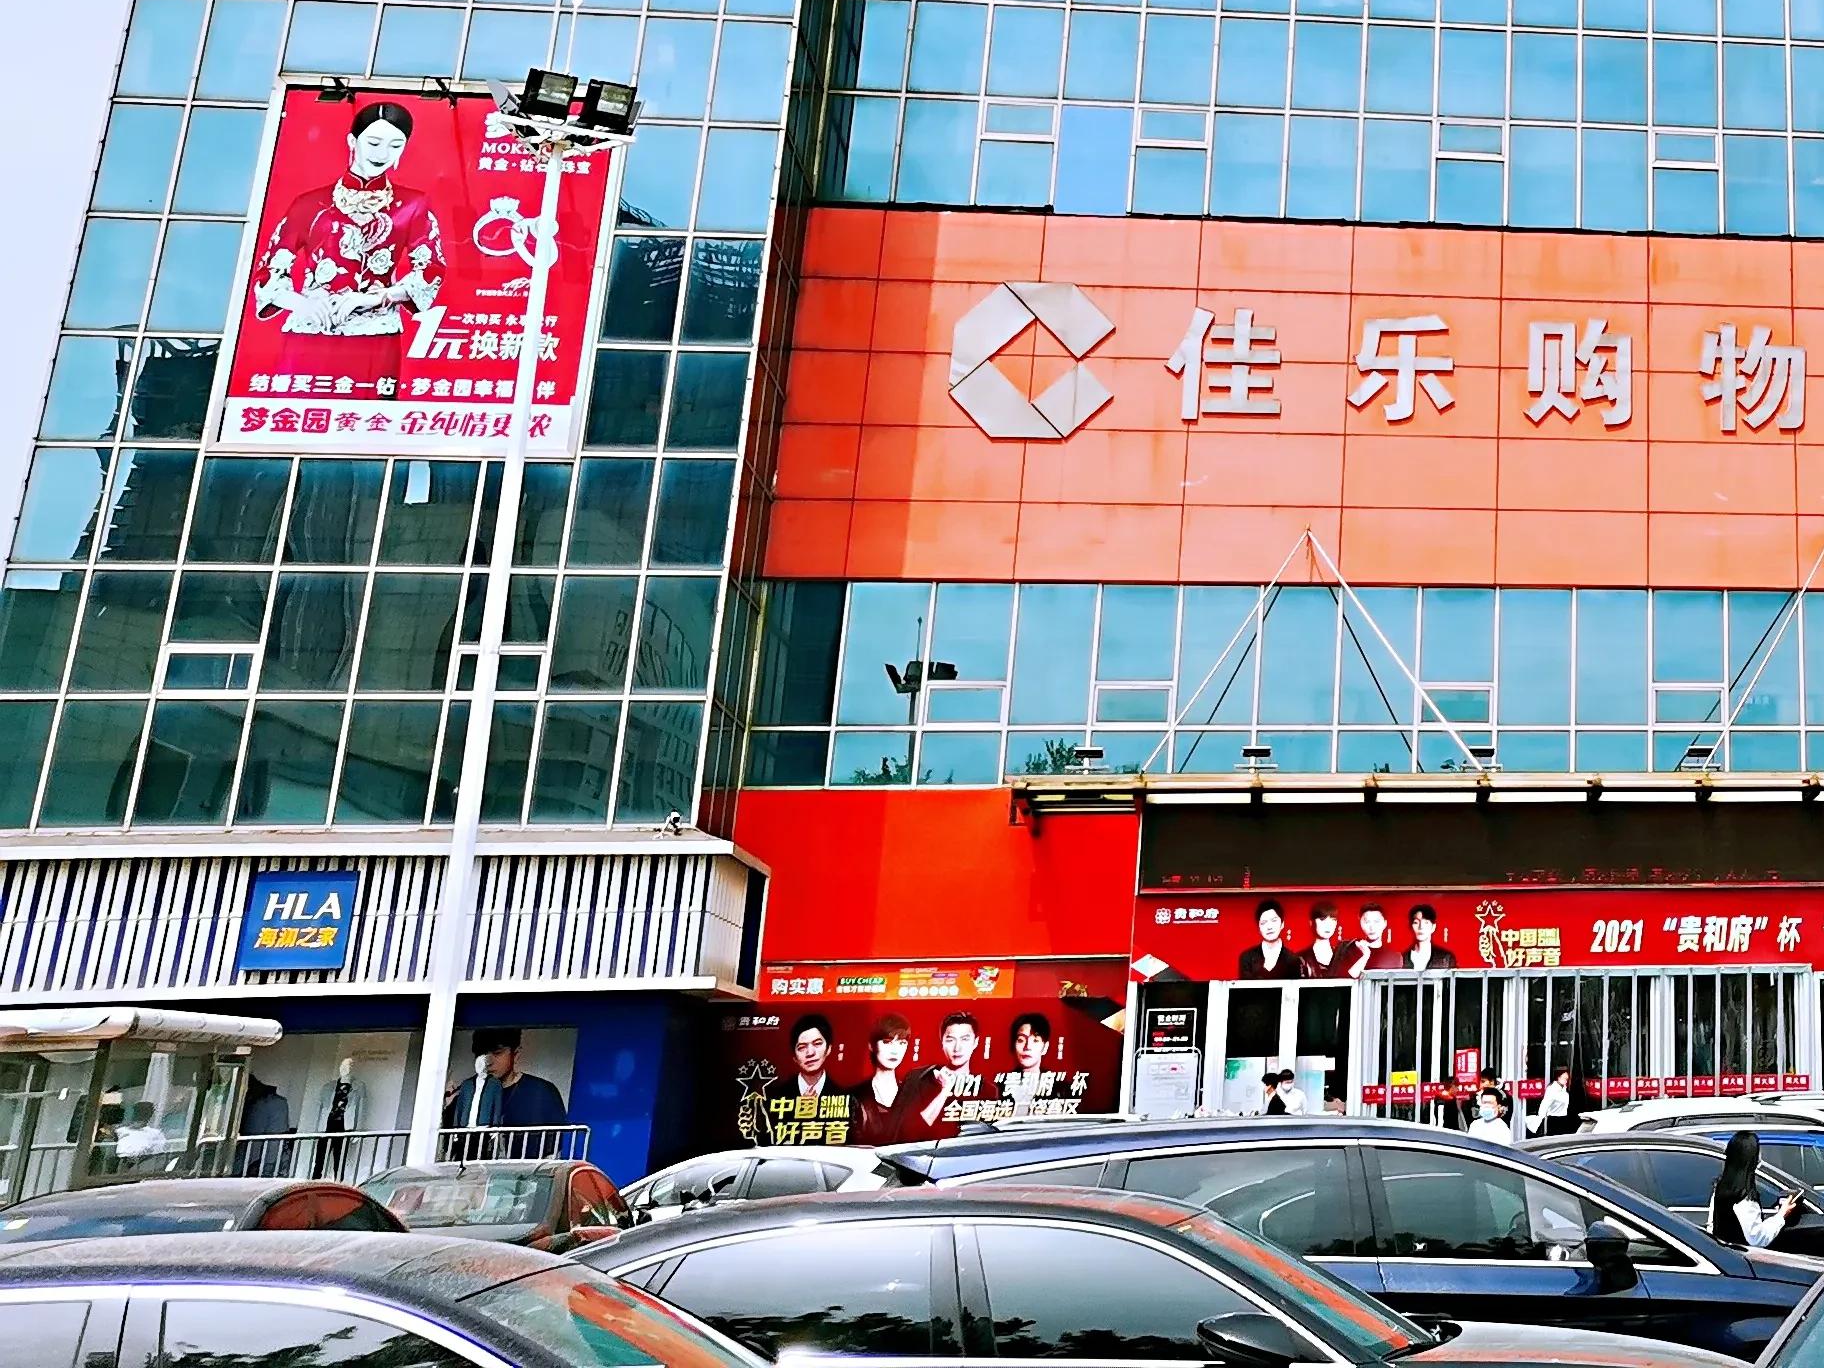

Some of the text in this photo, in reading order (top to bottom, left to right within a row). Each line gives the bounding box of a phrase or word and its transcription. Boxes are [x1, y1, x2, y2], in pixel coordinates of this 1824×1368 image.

[263, 893, 341, 921] HLA
[253, 927, 338, 949] 海澜之家
[1501, 929, 1538, 948] 中国
[1590, 919, 1645, 953] 2021
[1776, 915, 1804, 952] 杯
[1505, 947, 1561, 967] 好声音
[771, 977, 825, 995] 购实惠
[946, 1073, 980, 1097] 2021
[1071, 1072, 1090, 1096] 杯
[770, 1096, 819, 1120] 中国
[774, 1122, 849, 1145] 好声音
